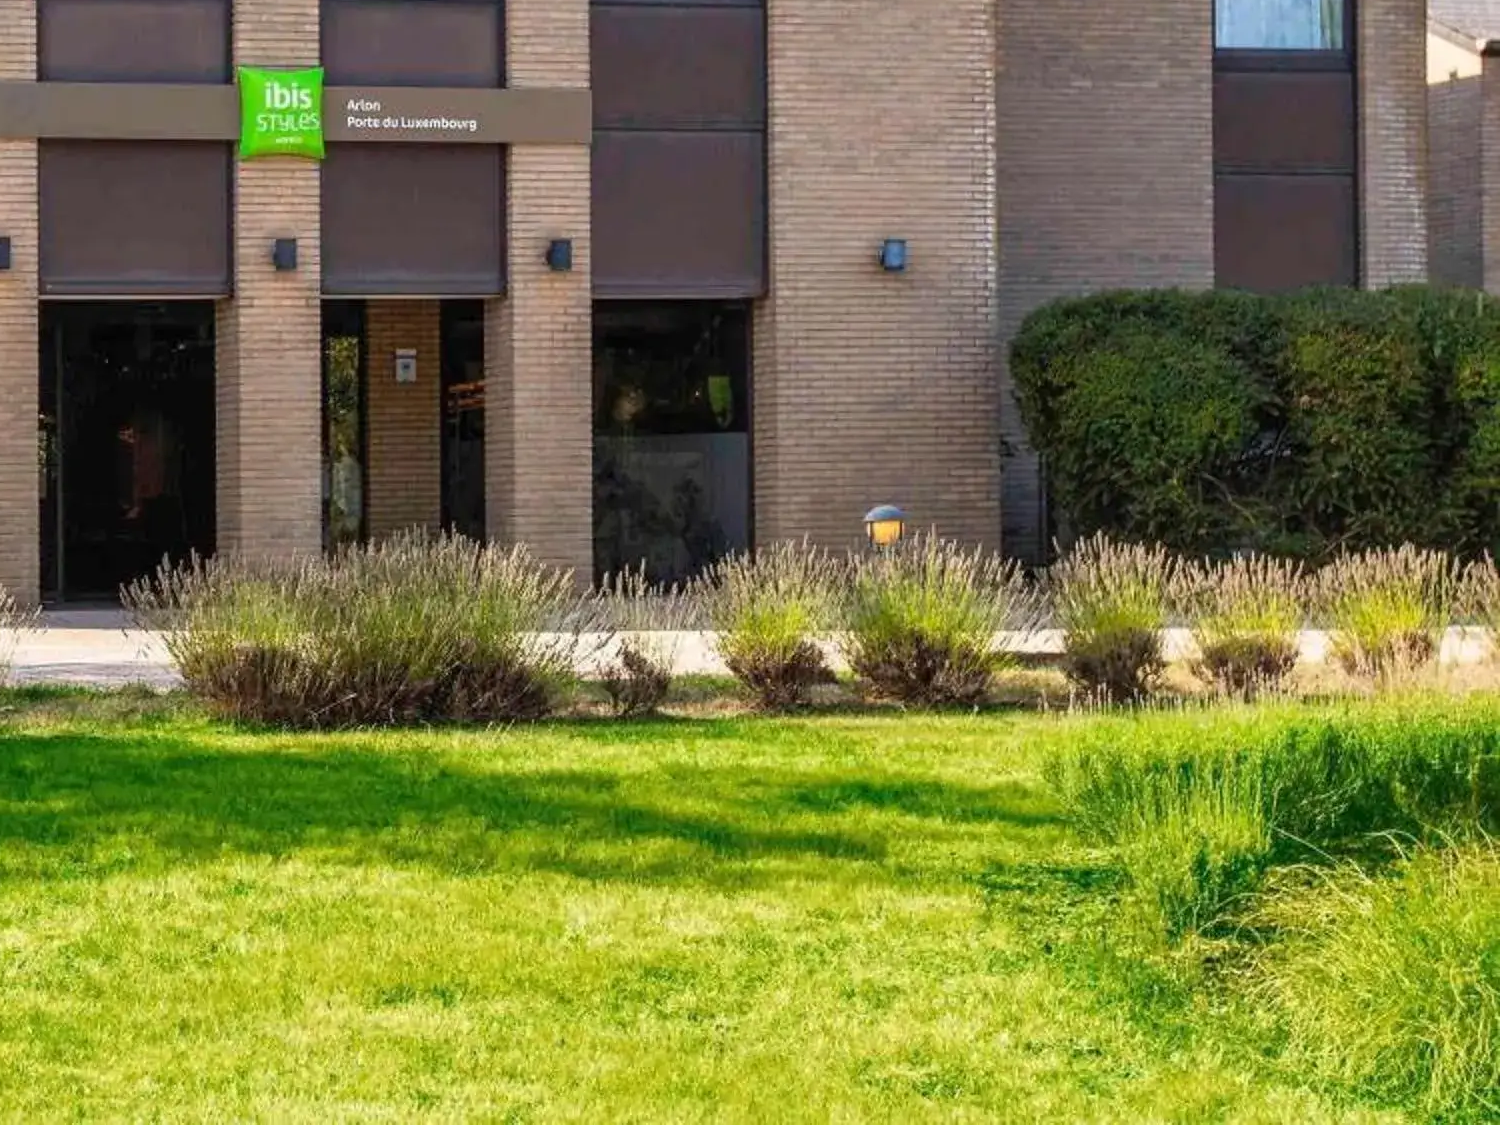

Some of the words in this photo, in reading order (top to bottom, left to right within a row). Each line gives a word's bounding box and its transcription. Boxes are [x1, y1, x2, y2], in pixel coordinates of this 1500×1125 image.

[264, 81, 312, 110] ibis
[347, 99, 381, 112] Arlon
[347, 116, 381, 129] Porte
[382, 117, 399, 129] du
[401, 117, 477, 132] Luxembourg
